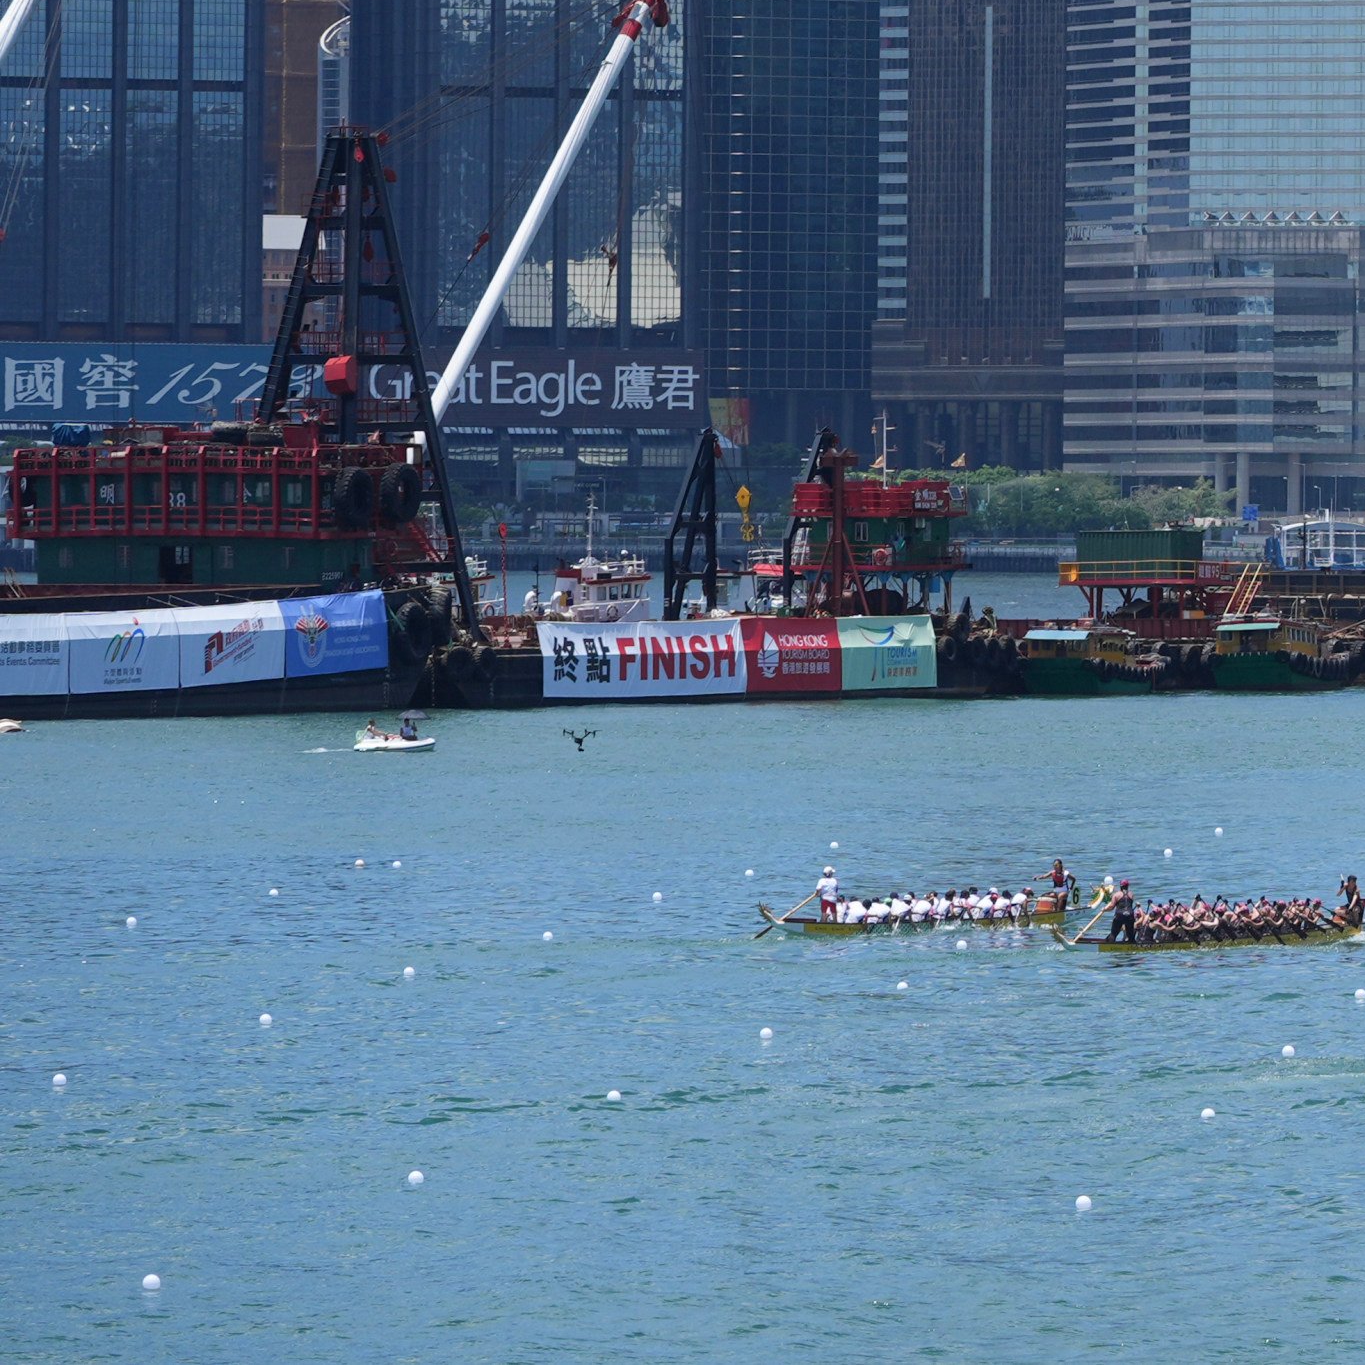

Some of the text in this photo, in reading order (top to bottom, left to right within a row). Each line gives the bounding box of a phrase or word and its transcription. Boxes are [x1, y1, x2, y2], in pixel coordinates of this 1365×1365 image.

[4, 354, 140, 412] 國窖
[490, 359, 602, 417] Eagle
[610, 362, 700, 411] 鷹君
[778, 634, 828, 647] HONG KONG
[6, 656, 27, 666] Events
[553, 635, 736, 683] 終點 FINISH
[782, 648, 830, 660] TOURISM BOARD
[1072, 887, 1080, 906] 6
